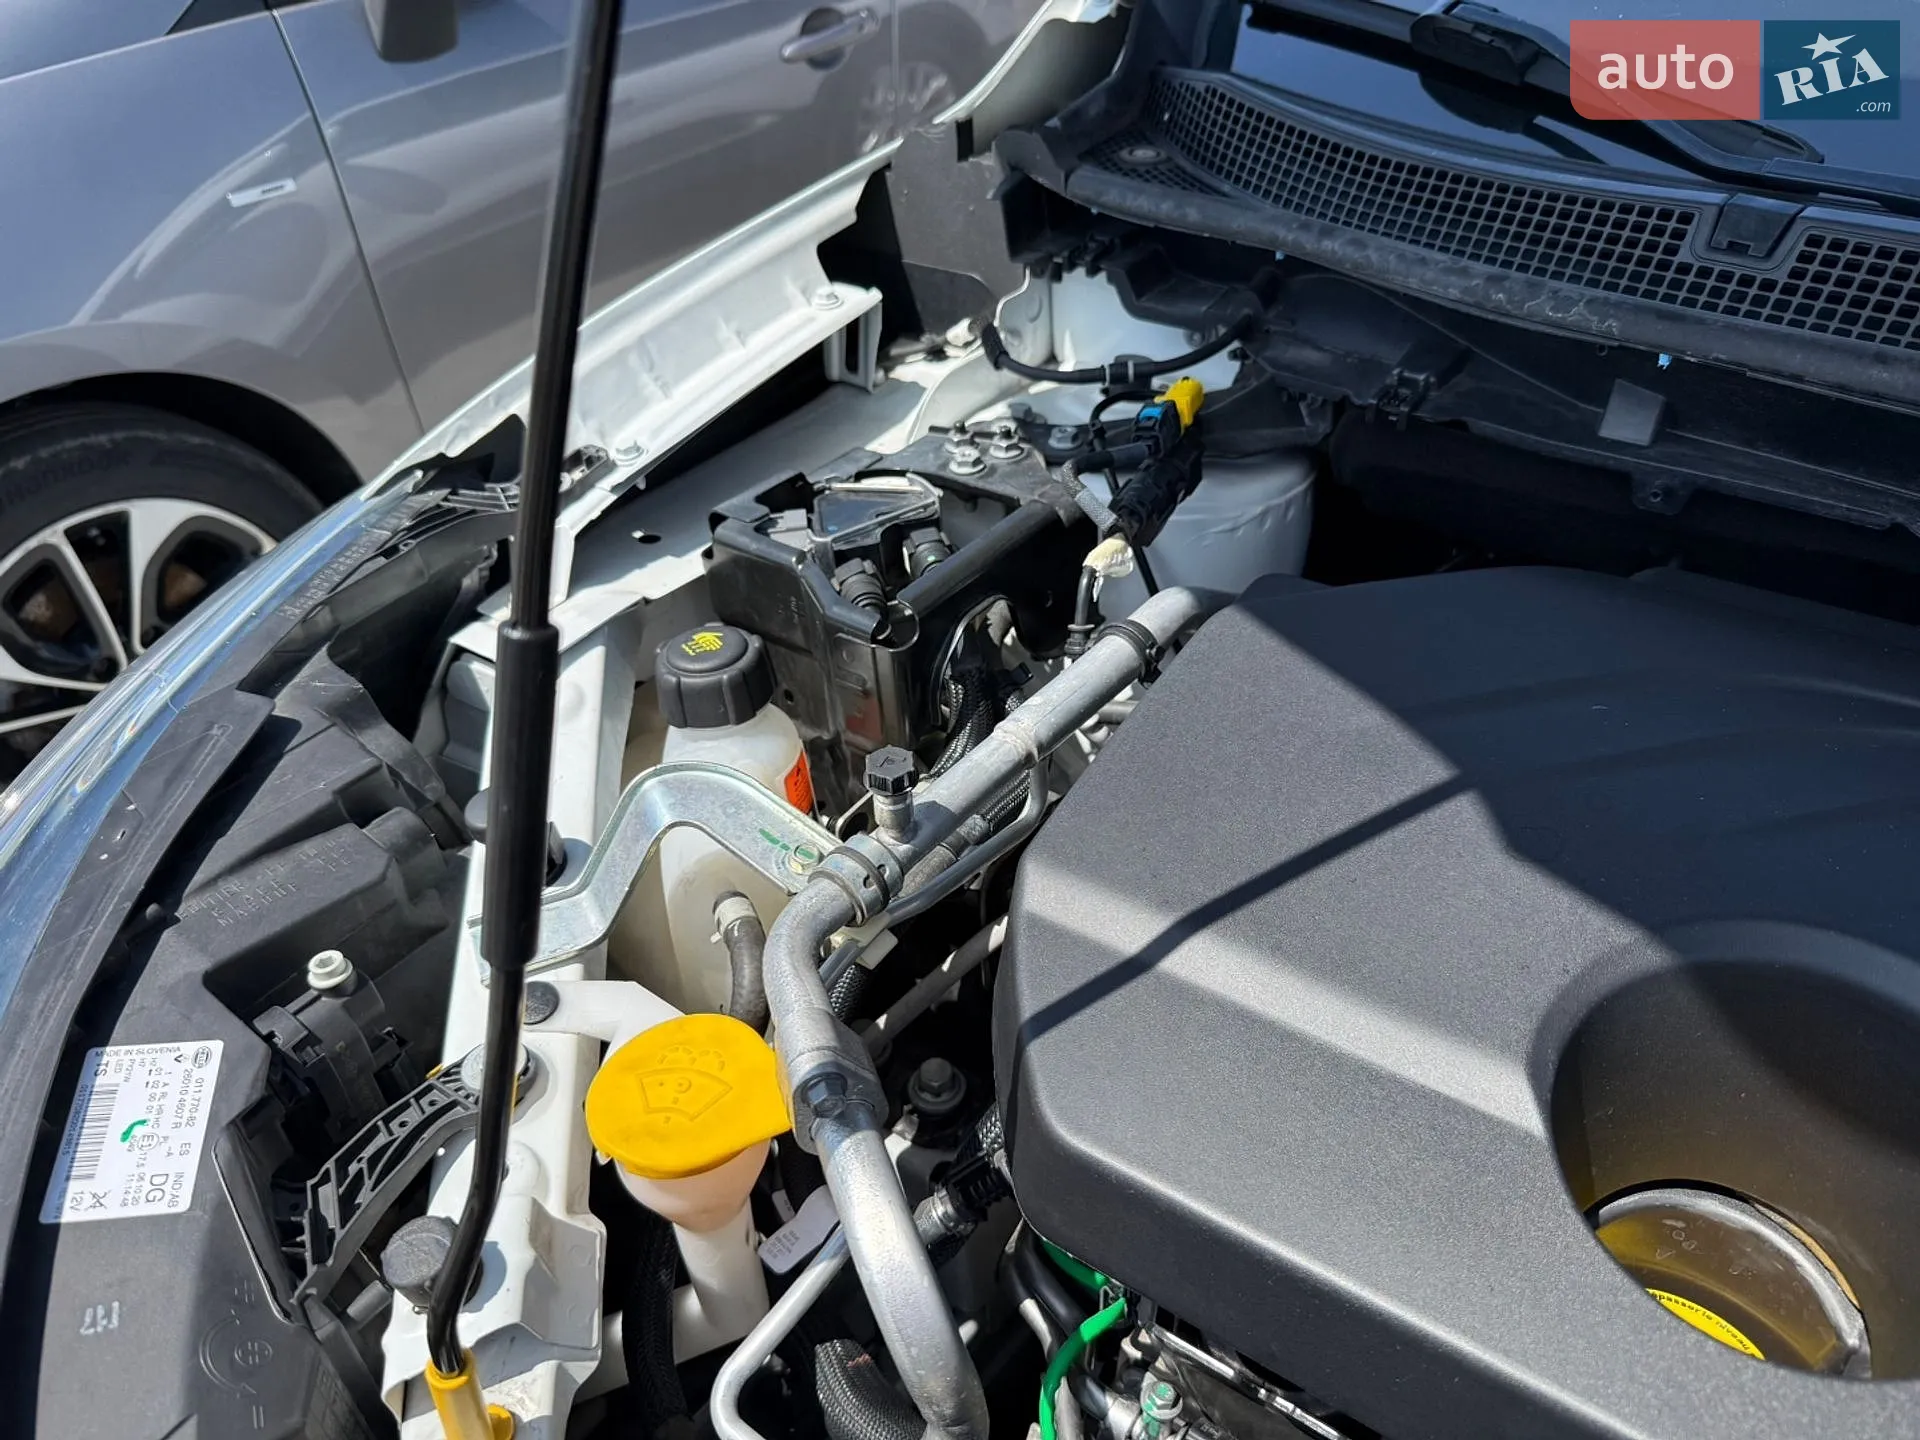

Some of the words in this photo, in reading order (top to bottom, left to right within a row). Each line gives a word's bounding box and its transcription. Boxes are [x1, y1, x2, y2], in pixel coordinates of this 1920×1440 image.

[93, 1060, 110, 1076] TS
[178, 1142, 191, 1156] ES
[145, 1173, 169, 1203] DG
